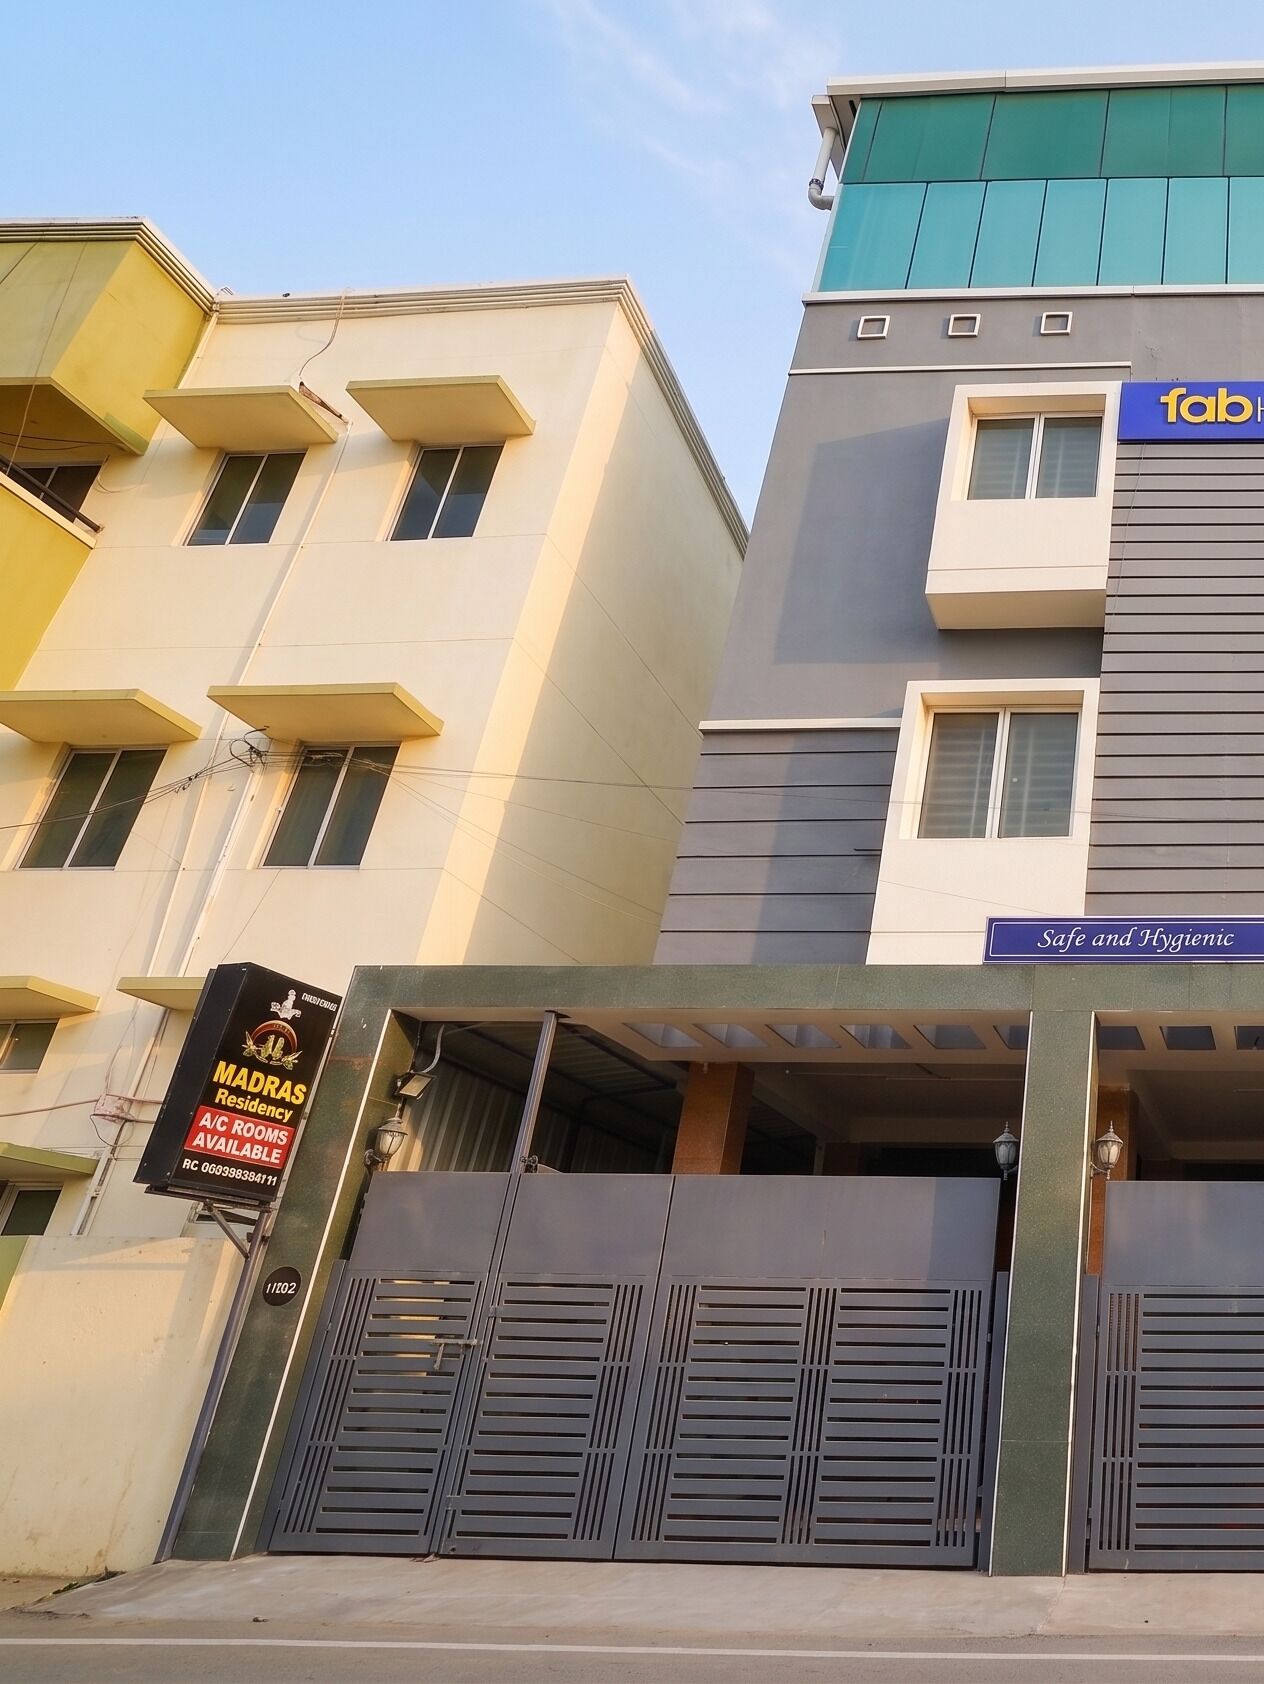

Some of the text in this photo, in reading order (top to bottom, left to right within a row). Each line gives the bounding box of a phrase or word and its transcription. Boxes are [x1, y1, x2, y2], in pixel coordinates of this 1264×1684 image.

[1036, 926, 1235, 953] Safe and Hygienic
[212, 1060, 307, 1105] MADRAS
[214, 1087, 294, 1123] Residency
[198, 1112, 289, 1146] A/C ROOMS
[191, 1132, 283, 1164] AVAILABLE
